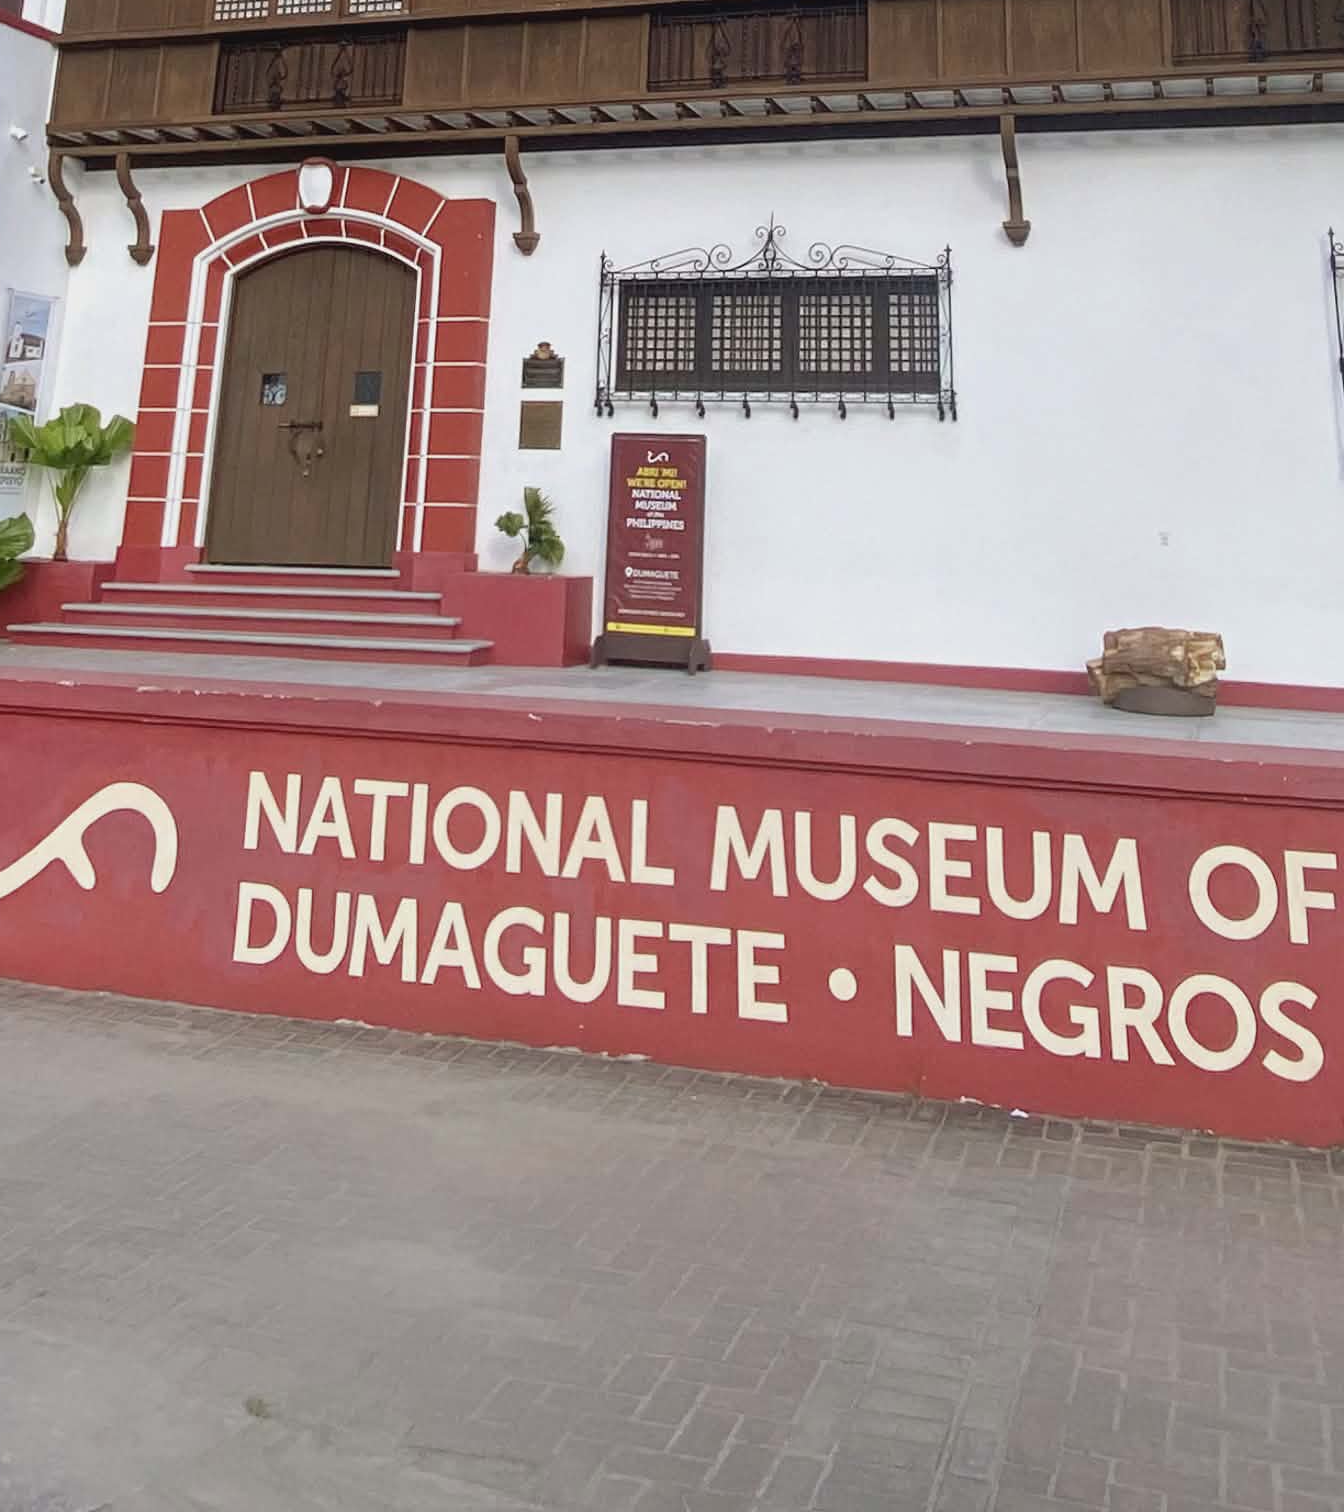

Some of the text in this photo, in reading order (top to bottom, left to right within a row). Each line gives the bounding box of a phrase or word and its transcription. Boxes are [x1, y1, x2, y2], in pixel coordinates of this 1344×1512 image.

[632, 489, 681, 500] NATIONAL
[635, 500, 677, 511] MUSEUM
[626, 518, 685, 530] PHILIPPINES
[242, 770, 676, 887] NATIONAL
[708, 804, 1149, 931] MUSEUM
[1187, 844, 1339, 945] OF
[231, 880, 789, 1024] DUMAGUETE
[893, 943, 1326, 1083] NEGROS
